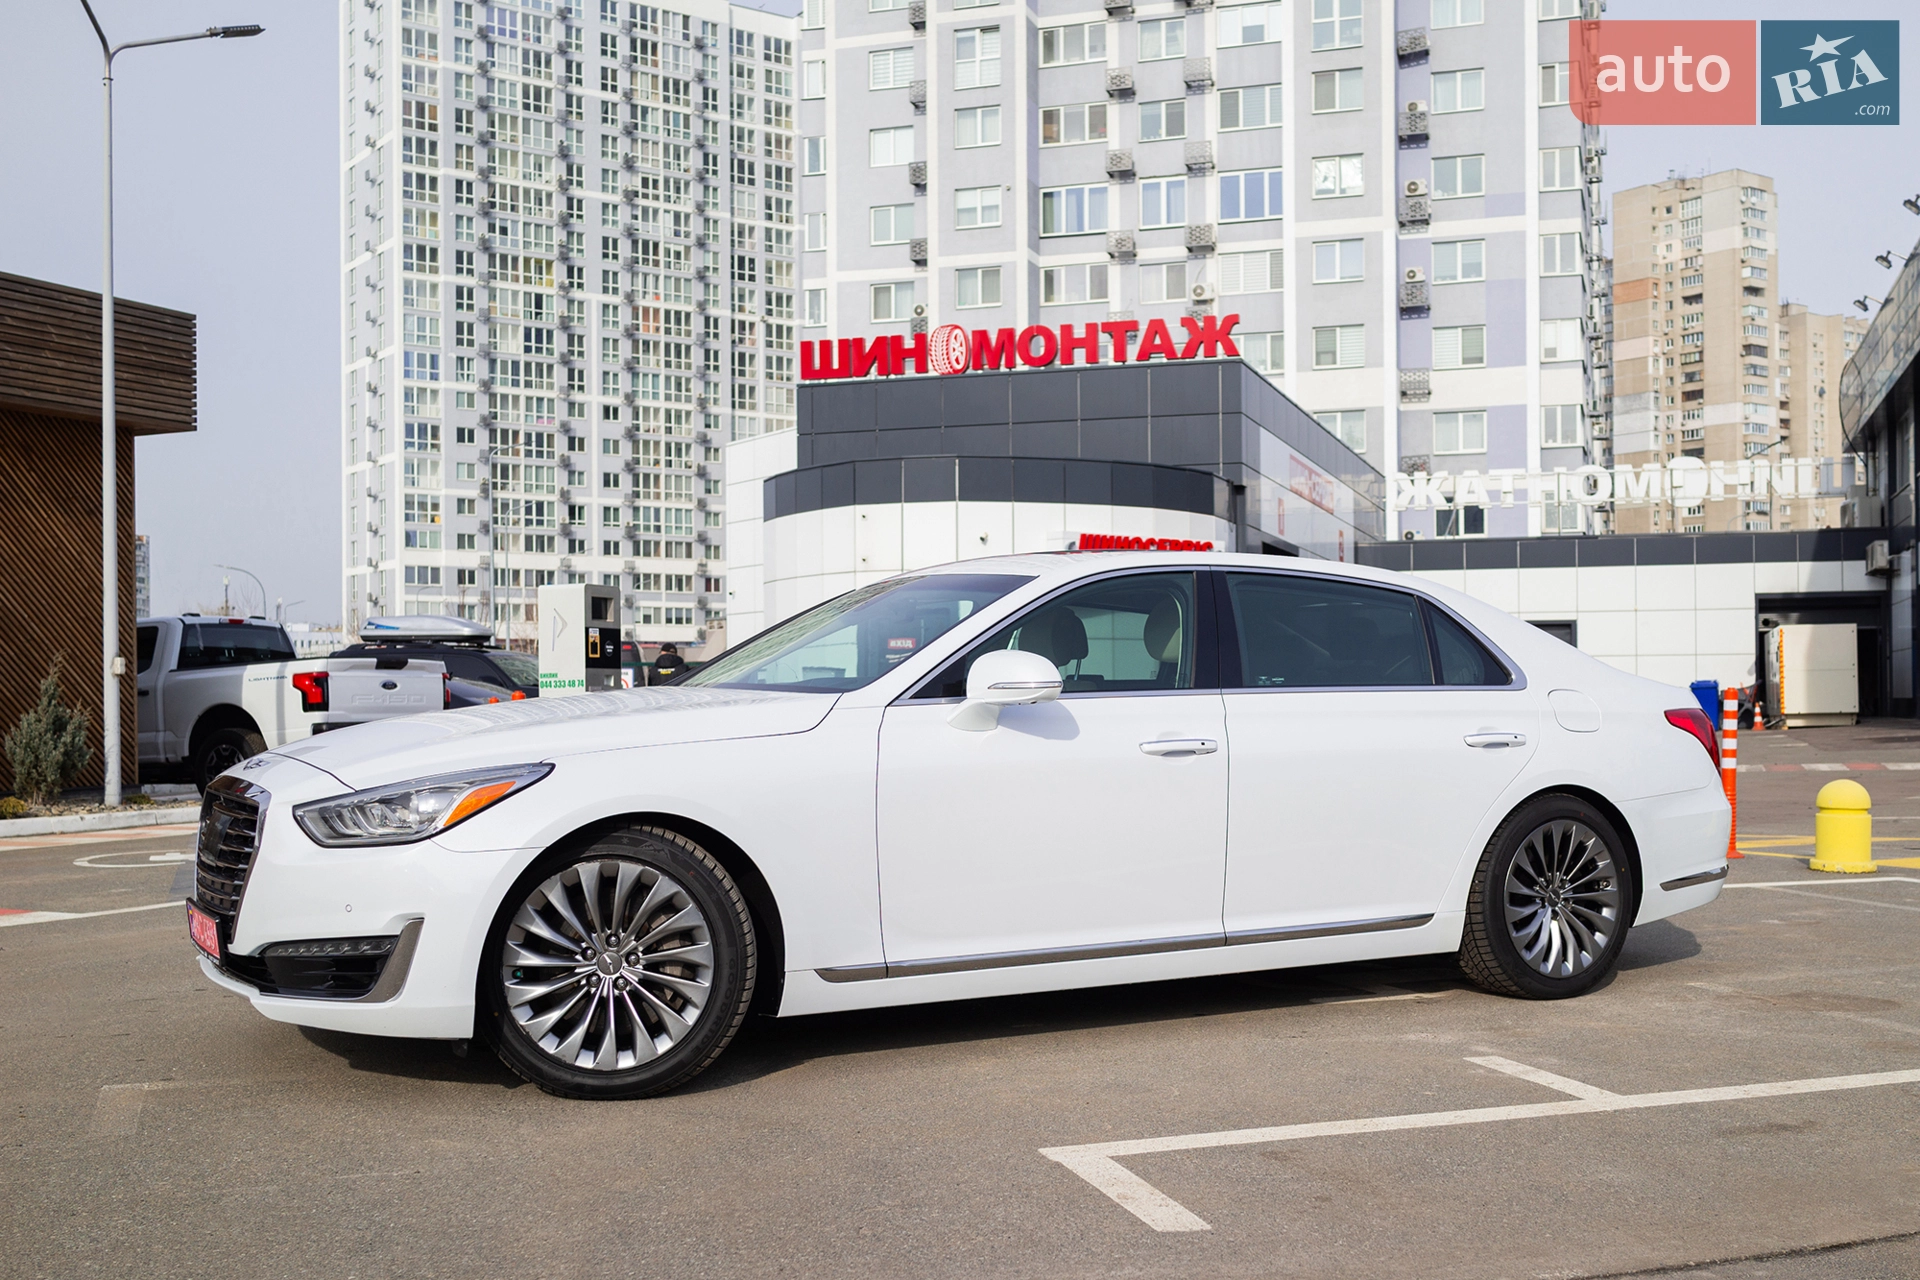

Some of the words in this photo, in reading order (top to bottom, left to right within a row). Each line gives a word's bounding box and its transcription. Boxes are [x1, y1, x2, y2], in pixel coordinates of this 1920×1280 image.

[540, 680, 552, 689] 044
[553, 680, 566, 688] 333
[567, 679, 576, 688] 48
[577, 679, 584, 687] 74
[351, 693, 427, 706] F-150
